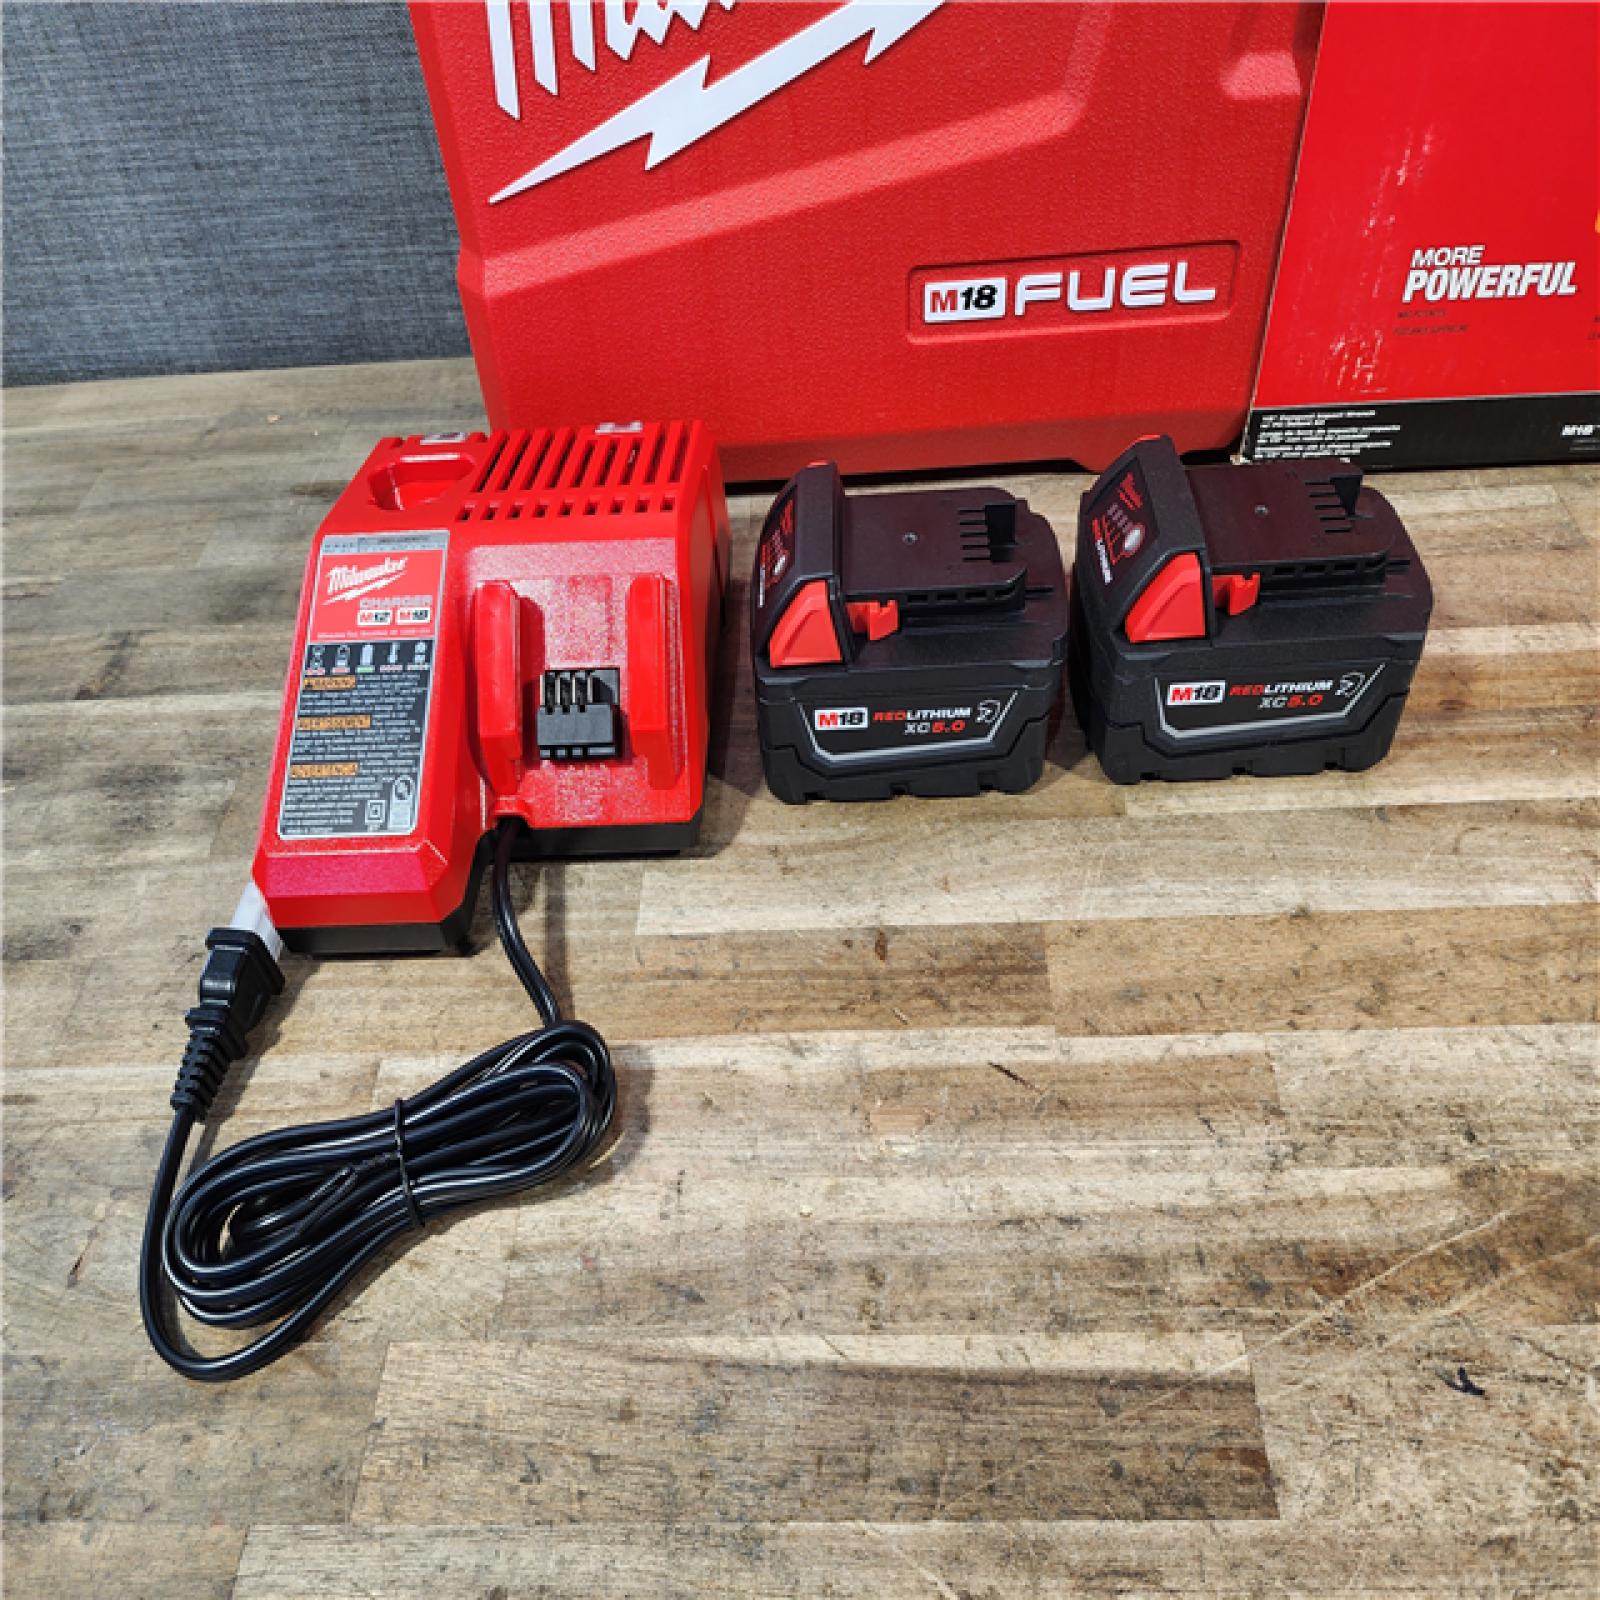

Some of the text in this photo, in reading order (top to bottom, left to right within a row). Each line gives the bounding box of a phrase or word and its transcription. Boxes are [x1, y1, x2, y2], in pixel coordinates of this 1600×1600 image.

[1411, 245, 1486, 268] MORE
[927, 260, 1217, 316] M18 FUEL
[1402, 262, 1578, 303] POWERFUL
[1171, 683, 1222, 702] M18
[817, 710, 866, 728] M18
